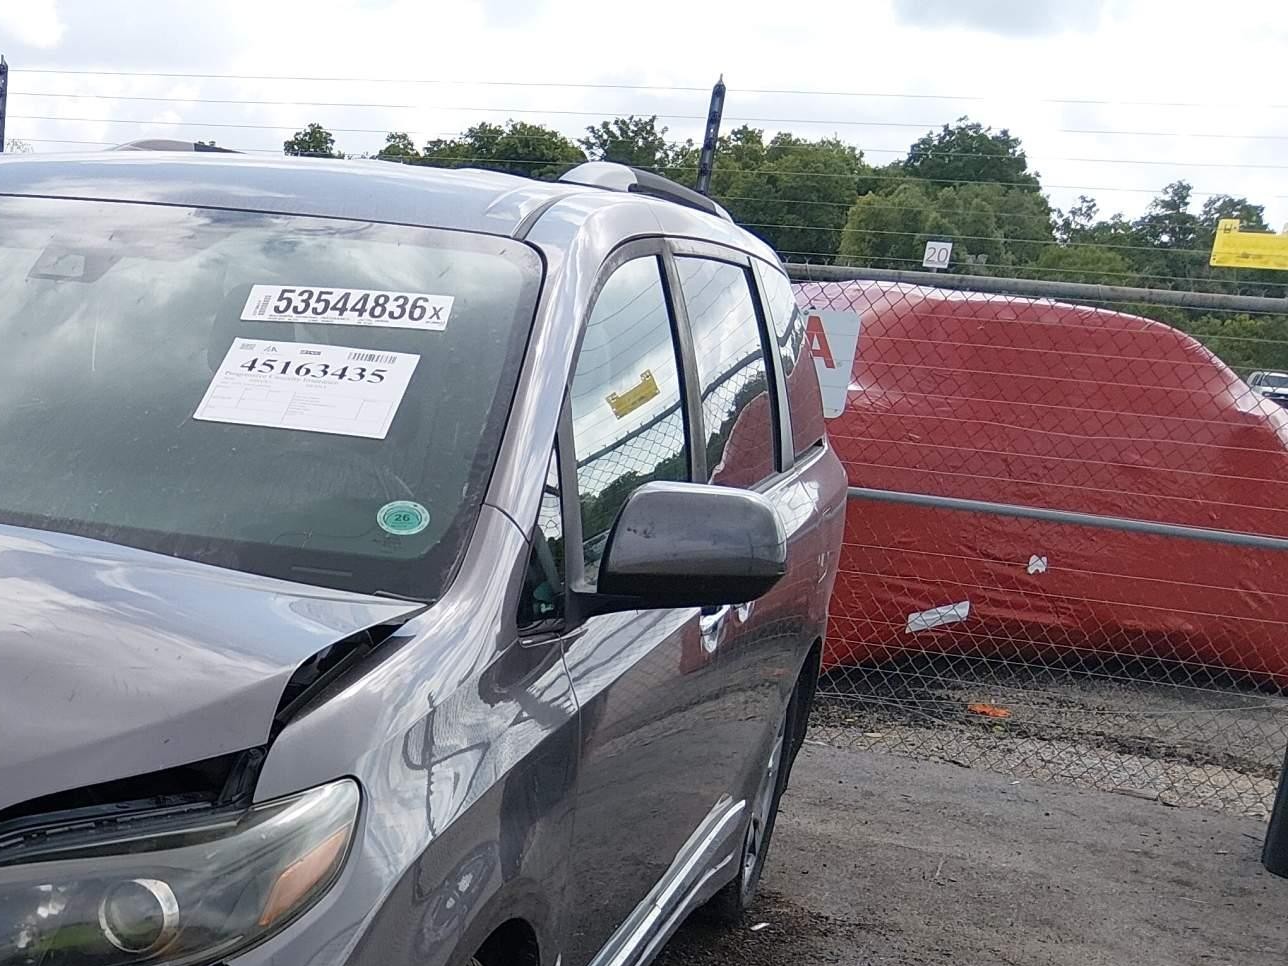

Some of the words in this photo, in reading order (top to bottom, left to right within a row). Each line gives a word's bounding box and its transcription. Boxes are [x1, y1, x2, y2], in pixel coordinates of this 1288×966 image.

[925, 246, 949, 263] 20
[805, 315, 836, 369] A
[240, 357, 388, 384] 45163435
[394, 513, 410, 521] 26
